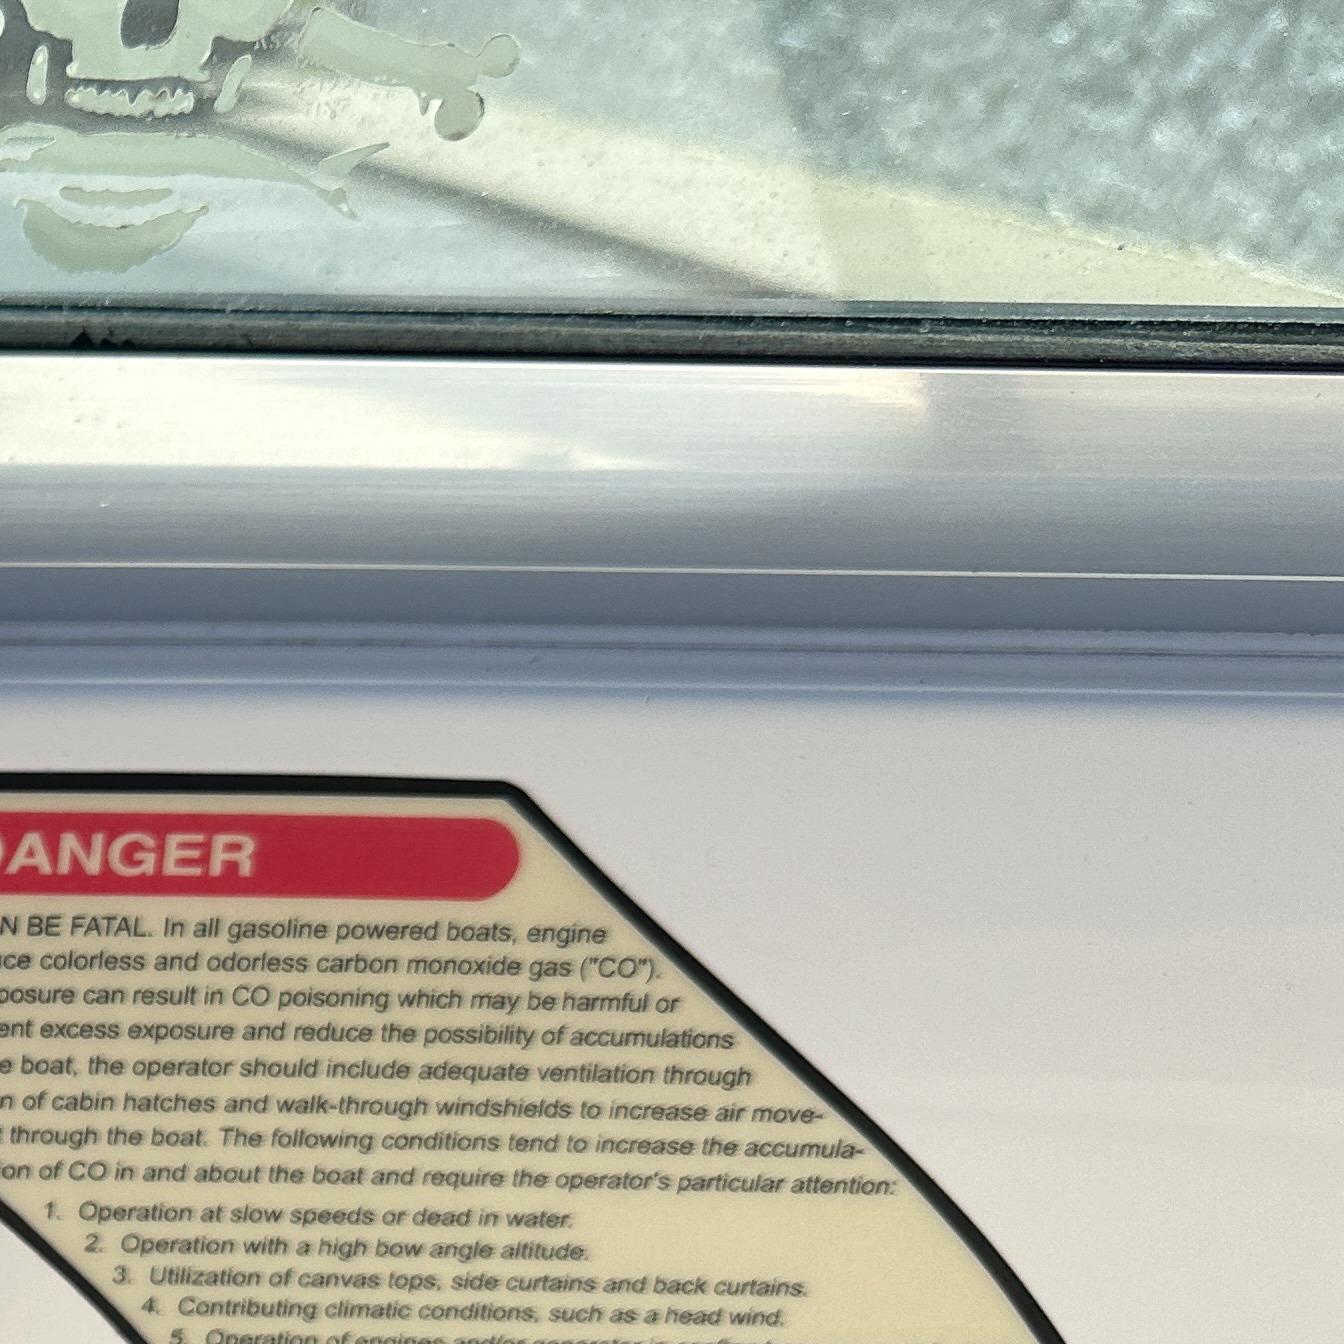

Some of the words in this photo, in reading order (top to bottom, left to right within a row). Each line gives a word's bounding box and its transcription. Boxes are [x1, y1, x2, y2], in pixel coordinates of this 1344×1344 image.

[26, 913, 63, 938] BE
[69, 913, 153, 938] FATAL.
[162, 917, 186, 938] In
[192, 916, 222, 939] all
[226, 917, 330, 945] gasoline
[334, 920, 441, 944] powered
[446, 920, 517, 946] boats,
[526, 923, 609, 950] engine
[39, 949, 146, 972] colorless
[153, 951, 202, 973] and
[206, 950, 310, 974] odorless
[315, 953, 400, 975] carbon
[406, 955, 524, 977] monoxide
[528, 959, 576, 983] gas
[82, 987, 128, 1005] can
[132, 984, 199, 1007] result
[203, 985, 226, 1006] in
[231, 983, 272, 1007] CO
[277, 986, 392, 1014] poisoning
[396, 987, 465, 1010] which
[470, 991, 523, 1016] may
[526, 990, 560, 1012] be
[561, 990, 652, 1013] harmful
[654, 996, 682, 1015] or
[44, 1202, 60, 1221] 1.
[79, 1202, 193, 1227] Operation
[200, 1206, 223, 1224] at
[229, 1204, 283, 1225] slow
[290, 1207, 375, 1231] speeds
[382, 1211, 408, 1227] or
[412, 1207, 472, 1228] dead
[478, 1208, 499, 1228] in
[505, 1210, 573, 1230] water.
